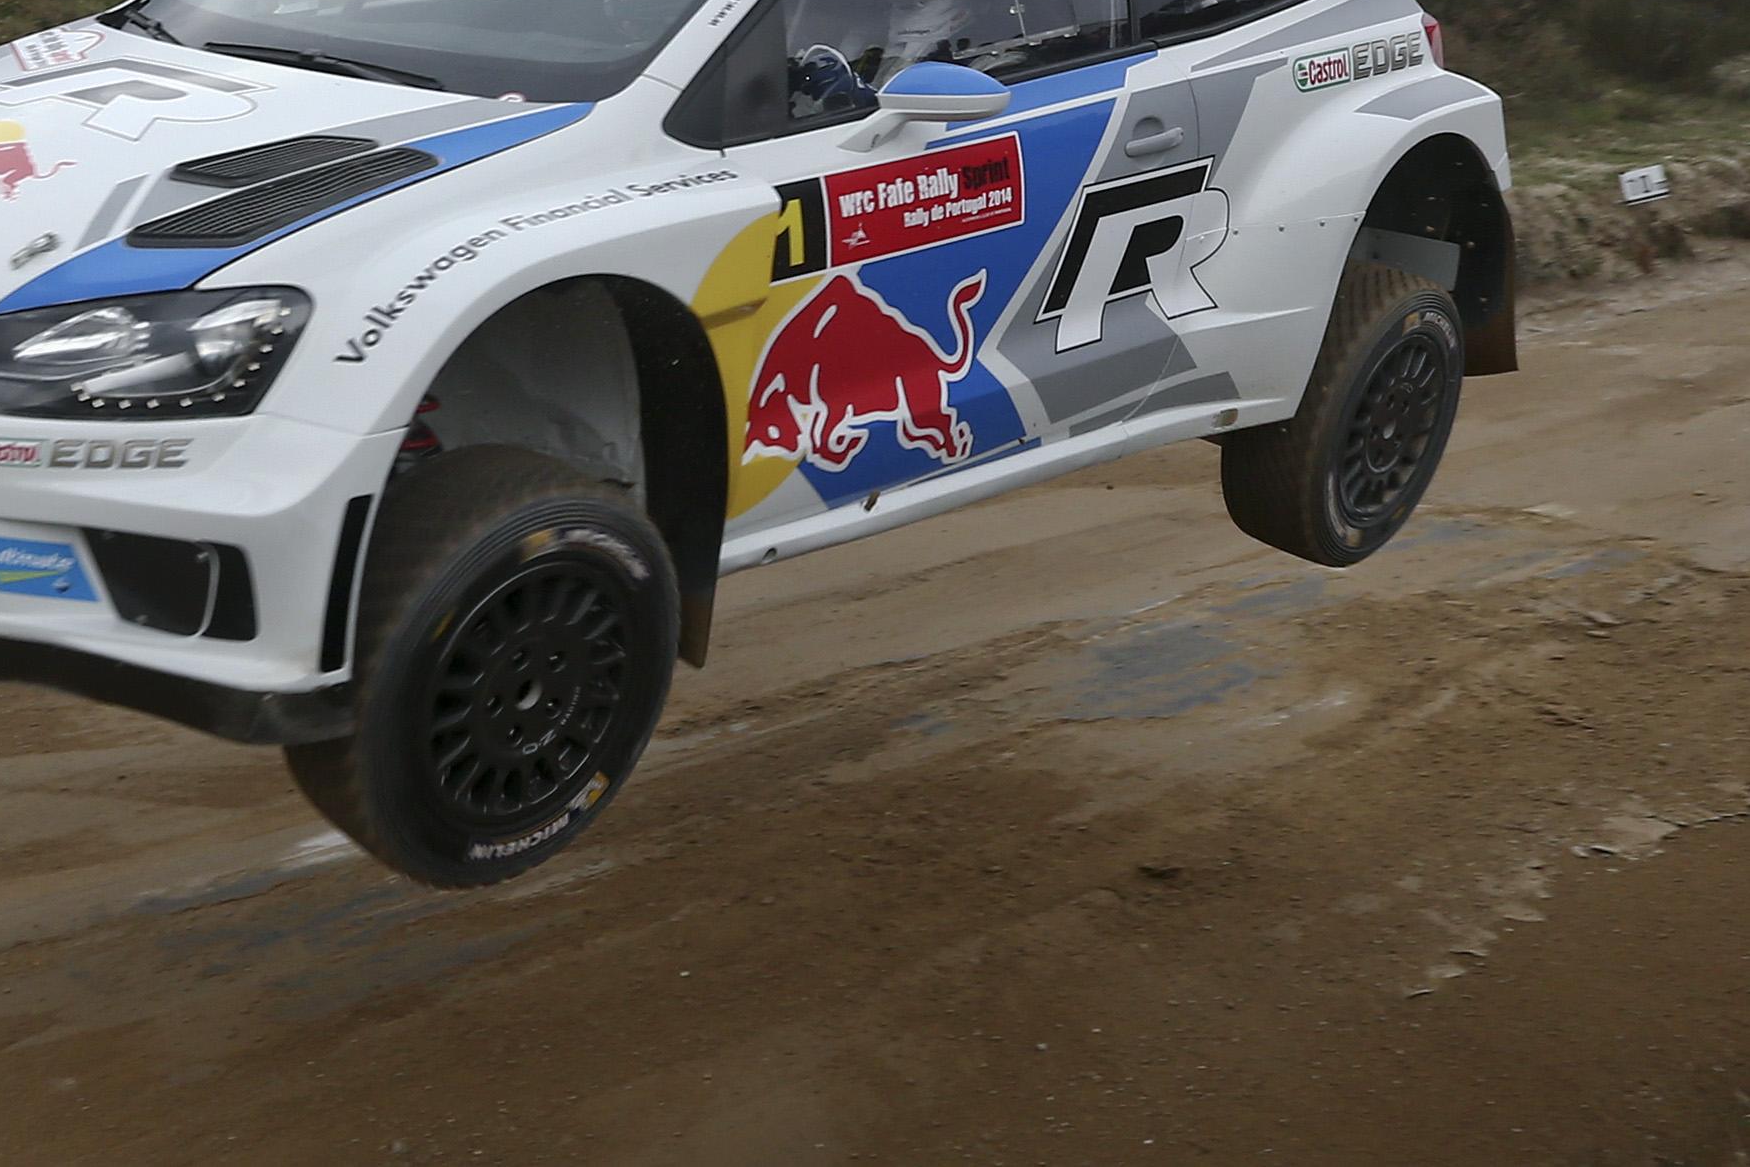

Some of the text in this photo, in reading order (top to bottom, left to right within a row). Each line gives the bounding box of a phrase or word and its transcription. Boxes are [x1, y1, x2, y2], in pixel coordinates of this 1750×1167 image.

[1308, 31, 1425, 86] Castrol EDGE
[877, 178, 914, 209] Fafe
[916, 167, 958, 200] Rally
[962, 156, 1010, 189] Sprint
[904, 207, 930, 228] Rally
[931, 204, 945, 221] de
[945, 192, 987, 218] Portugal
[988, 186, 1013, 208] 2014
[777, 198, 805, 267] 1
[333, 167, 739, 366] Volkswagen Financial Services
[48, 438, 194, 469] EDGE
[468, 812, 570, 860] MICHELIN
